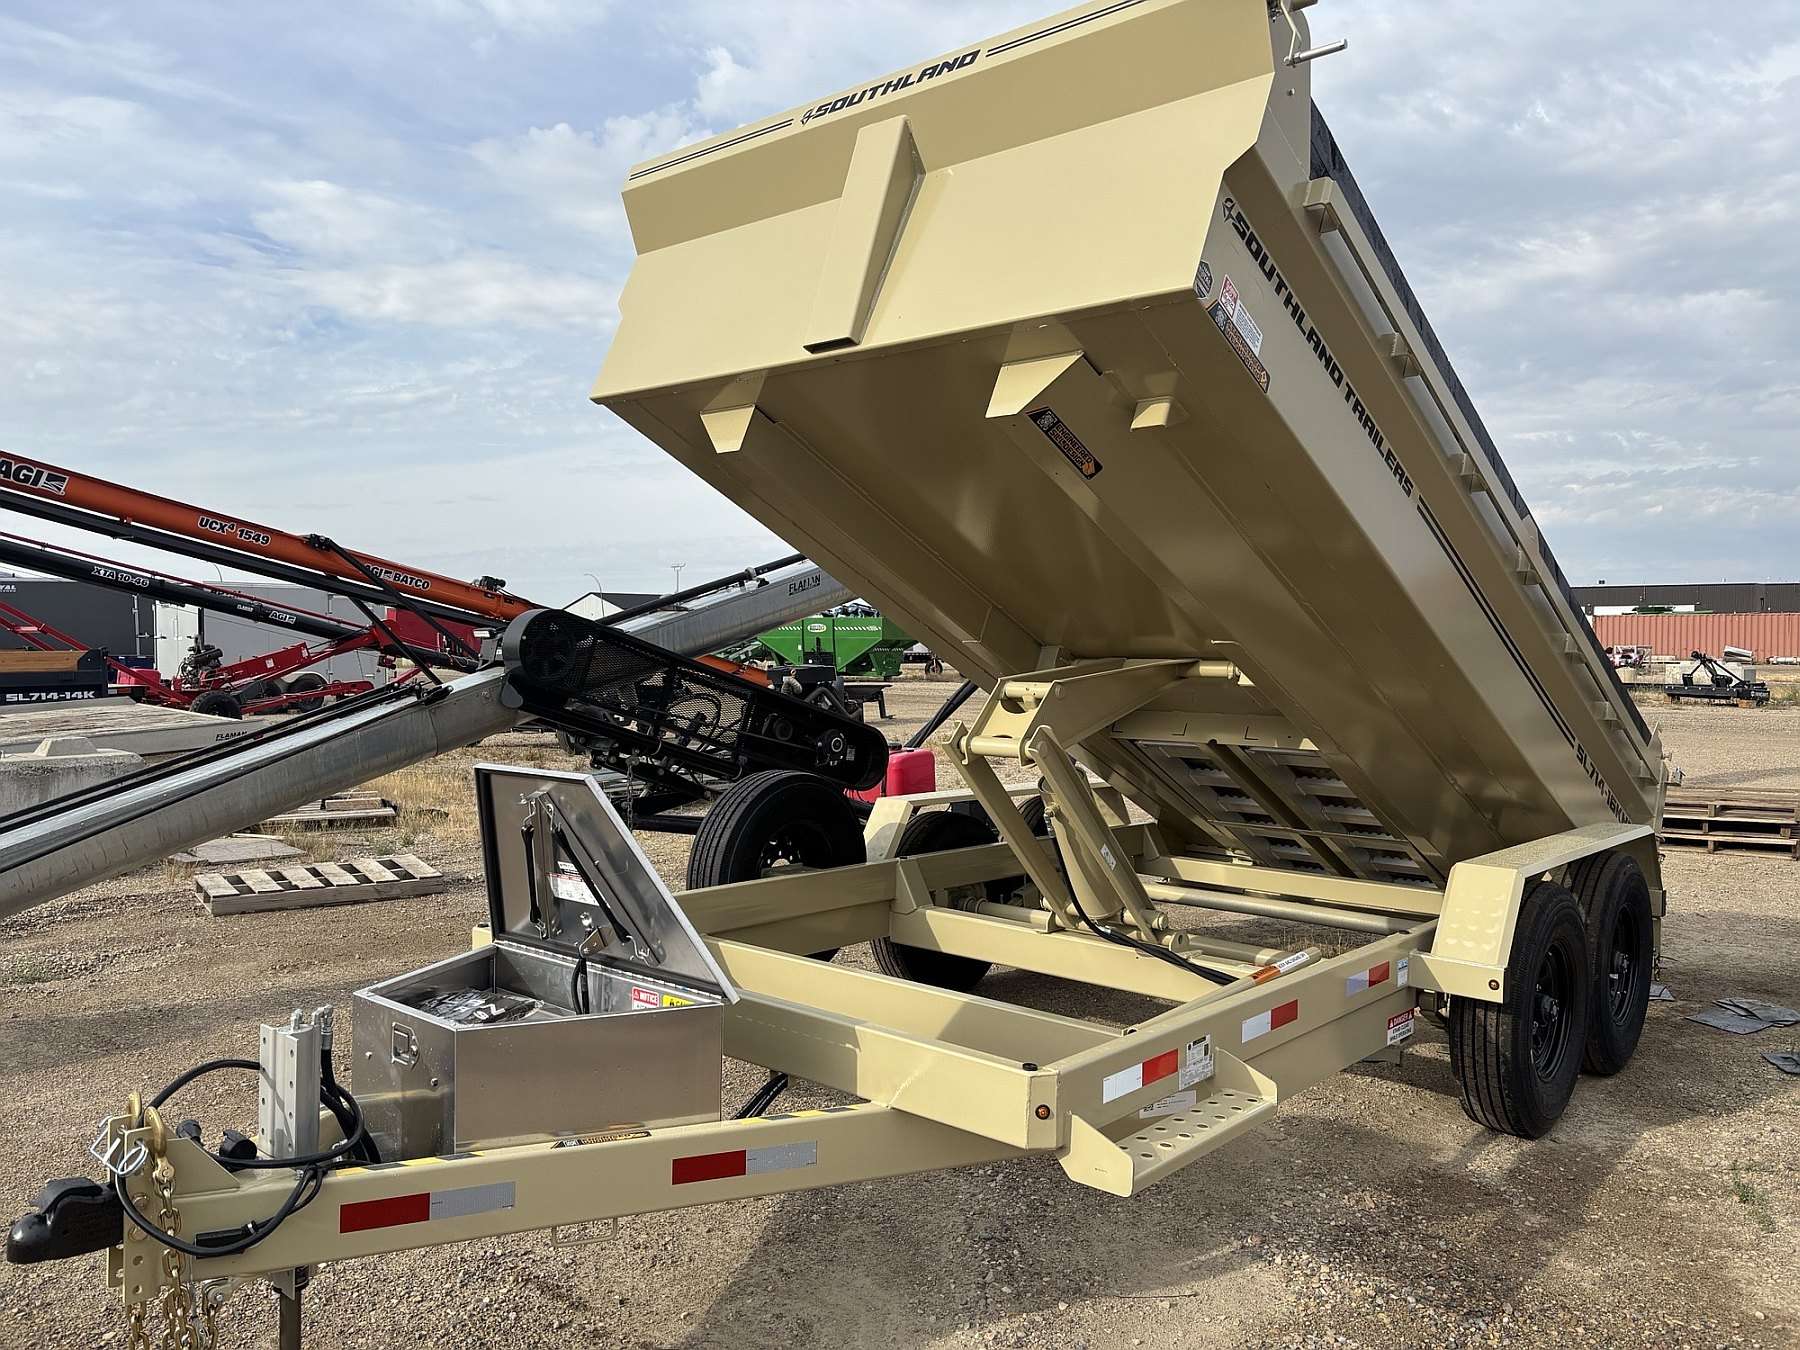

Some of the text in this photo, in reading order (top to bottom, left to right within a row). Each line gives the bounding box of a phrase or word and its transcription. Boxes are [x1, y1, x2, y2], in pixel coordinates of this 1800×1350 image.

[811, 49, 982, 120] SOUTHLAND
[1232, 211, 1345, 389] SOUTHLAND
[1344, 381, 1415, 498] TRAILERS
[1055, 422, 1094, 464] ENGINEERED
[0, 457, 46, 489] AGI
[237, 527, 271, 547] 1549
[91, 566, 117, 580] XTA
[393, 571, 432, 591] BATCO
[269, 610, 288, 622] AGI
[6, 691, 96, 702] SL714-14K
[1393, 1012, 1409, 1027] DANGER
